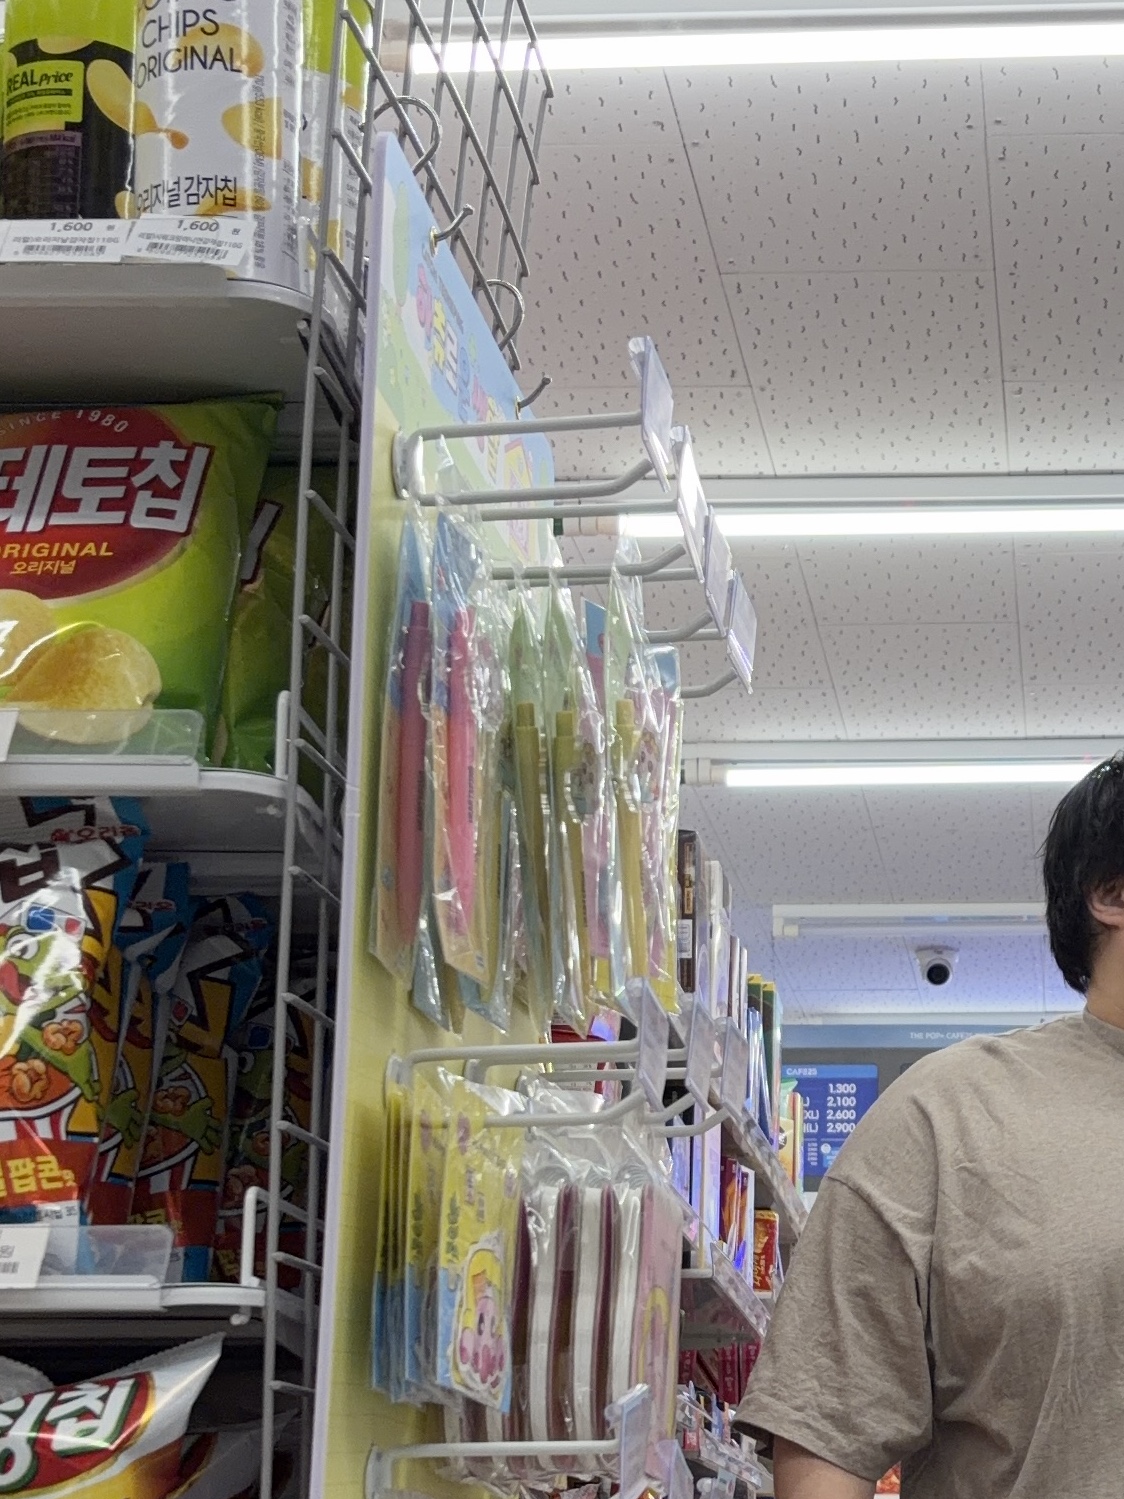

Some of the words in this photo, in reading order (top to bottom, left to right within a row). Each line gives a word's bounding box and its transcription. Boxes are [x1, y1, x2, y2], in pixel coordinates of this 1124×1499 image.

[142, 9, 220, 48] CHIPS
[137, 46, 243, 89] ORIGINAL
[6, 69, 37, 96] REAL
[39, 70, 74, 87] Price
[185, 174, 237, 207] 감자칩
[51, 222, 93, 232] 1,600
[177, 220, 220, 233] 1,600
[75, 409, 130, 433] 1980
[10, 560, 76, 575] 오리지널
